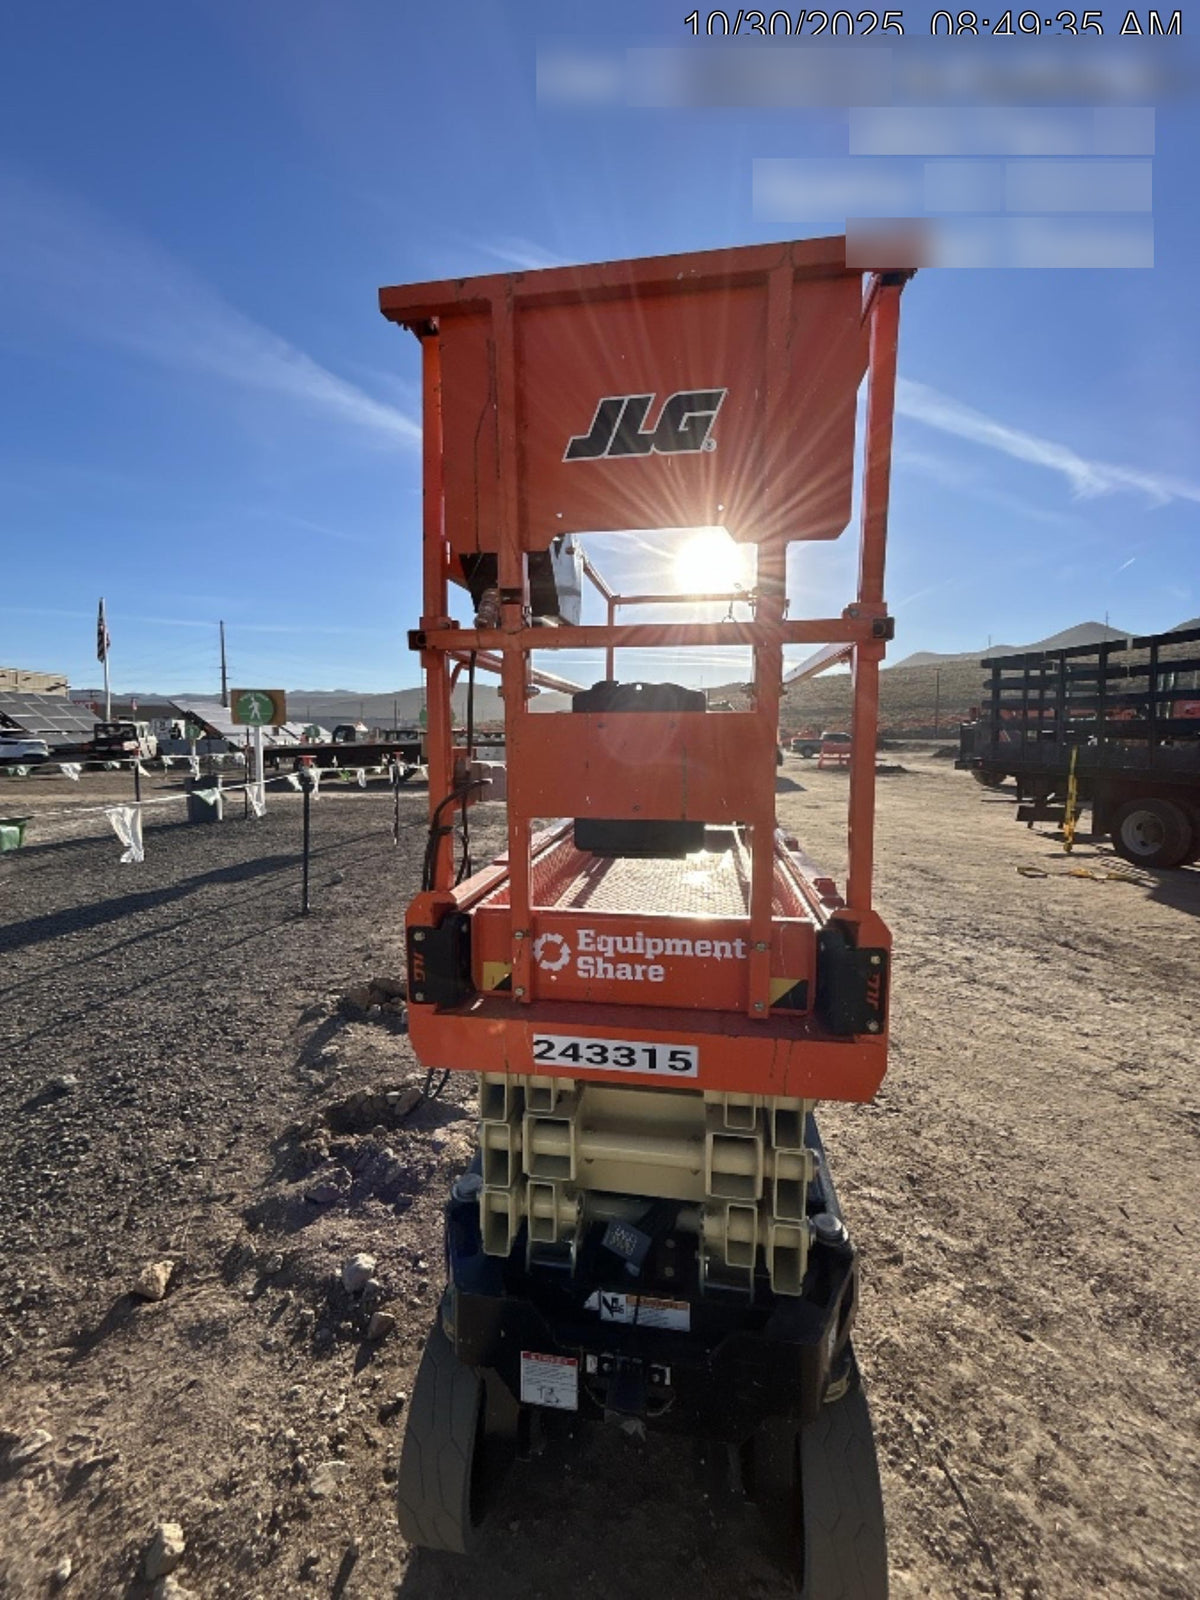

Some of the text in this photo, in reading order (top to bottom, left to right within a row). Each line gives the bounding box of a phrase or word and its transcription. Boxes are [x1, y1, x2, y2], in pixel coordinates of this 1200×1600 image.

[562, 388, 728, 462] JLG
[578, 929, 746, 960] Equipment
[577, 957, 665, 982] Share
[534, 1039, 693, 1072] 243315
